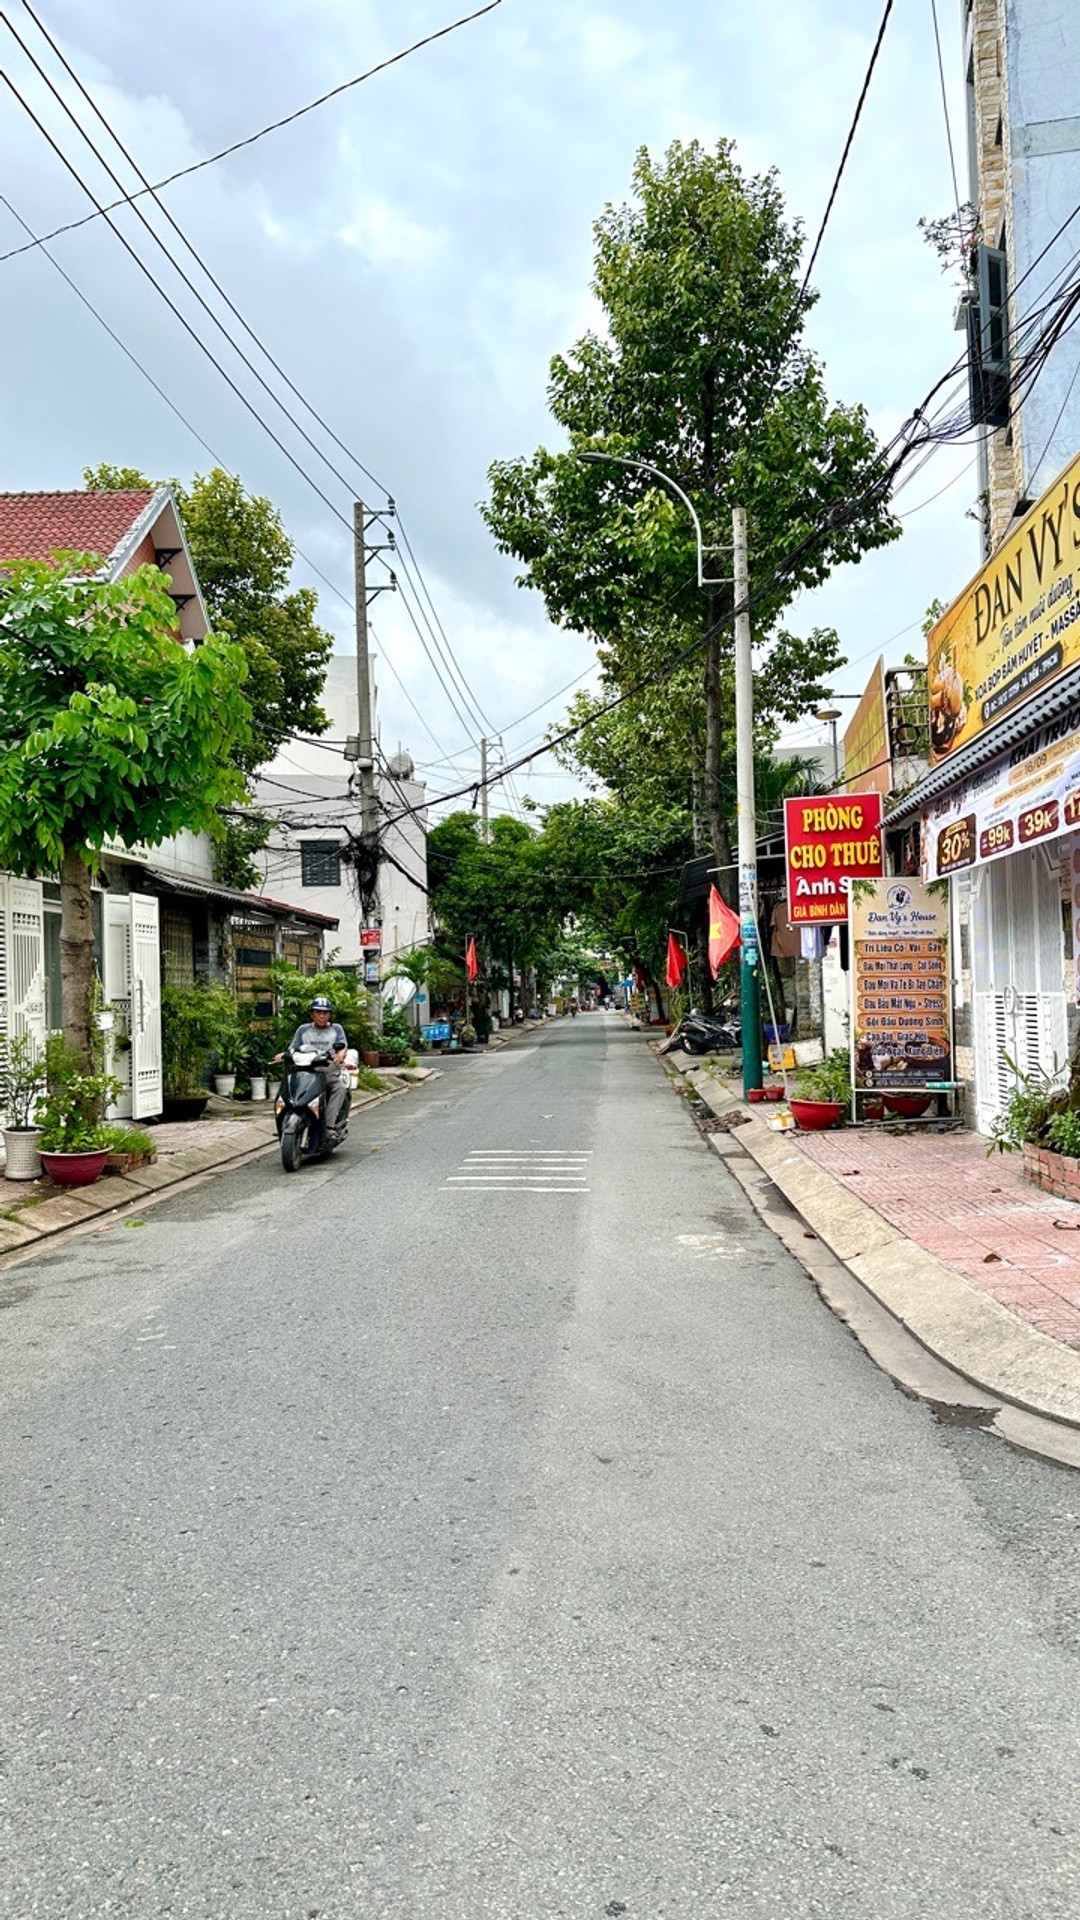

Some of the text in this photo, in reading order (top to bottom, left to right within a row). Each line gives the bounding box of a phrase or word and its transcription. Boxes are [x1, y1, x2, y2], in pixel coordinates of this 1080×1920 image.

[802, 803, 863, 832] PHÒNG
[1024, 809, 1053, 837] 39k
[941, 831, 970, 865] 30%
[988, 825, 1011, 848] 99k
[790, 835, 880, 869] CHO THUÊ
[910, 911, 937, 922] House
